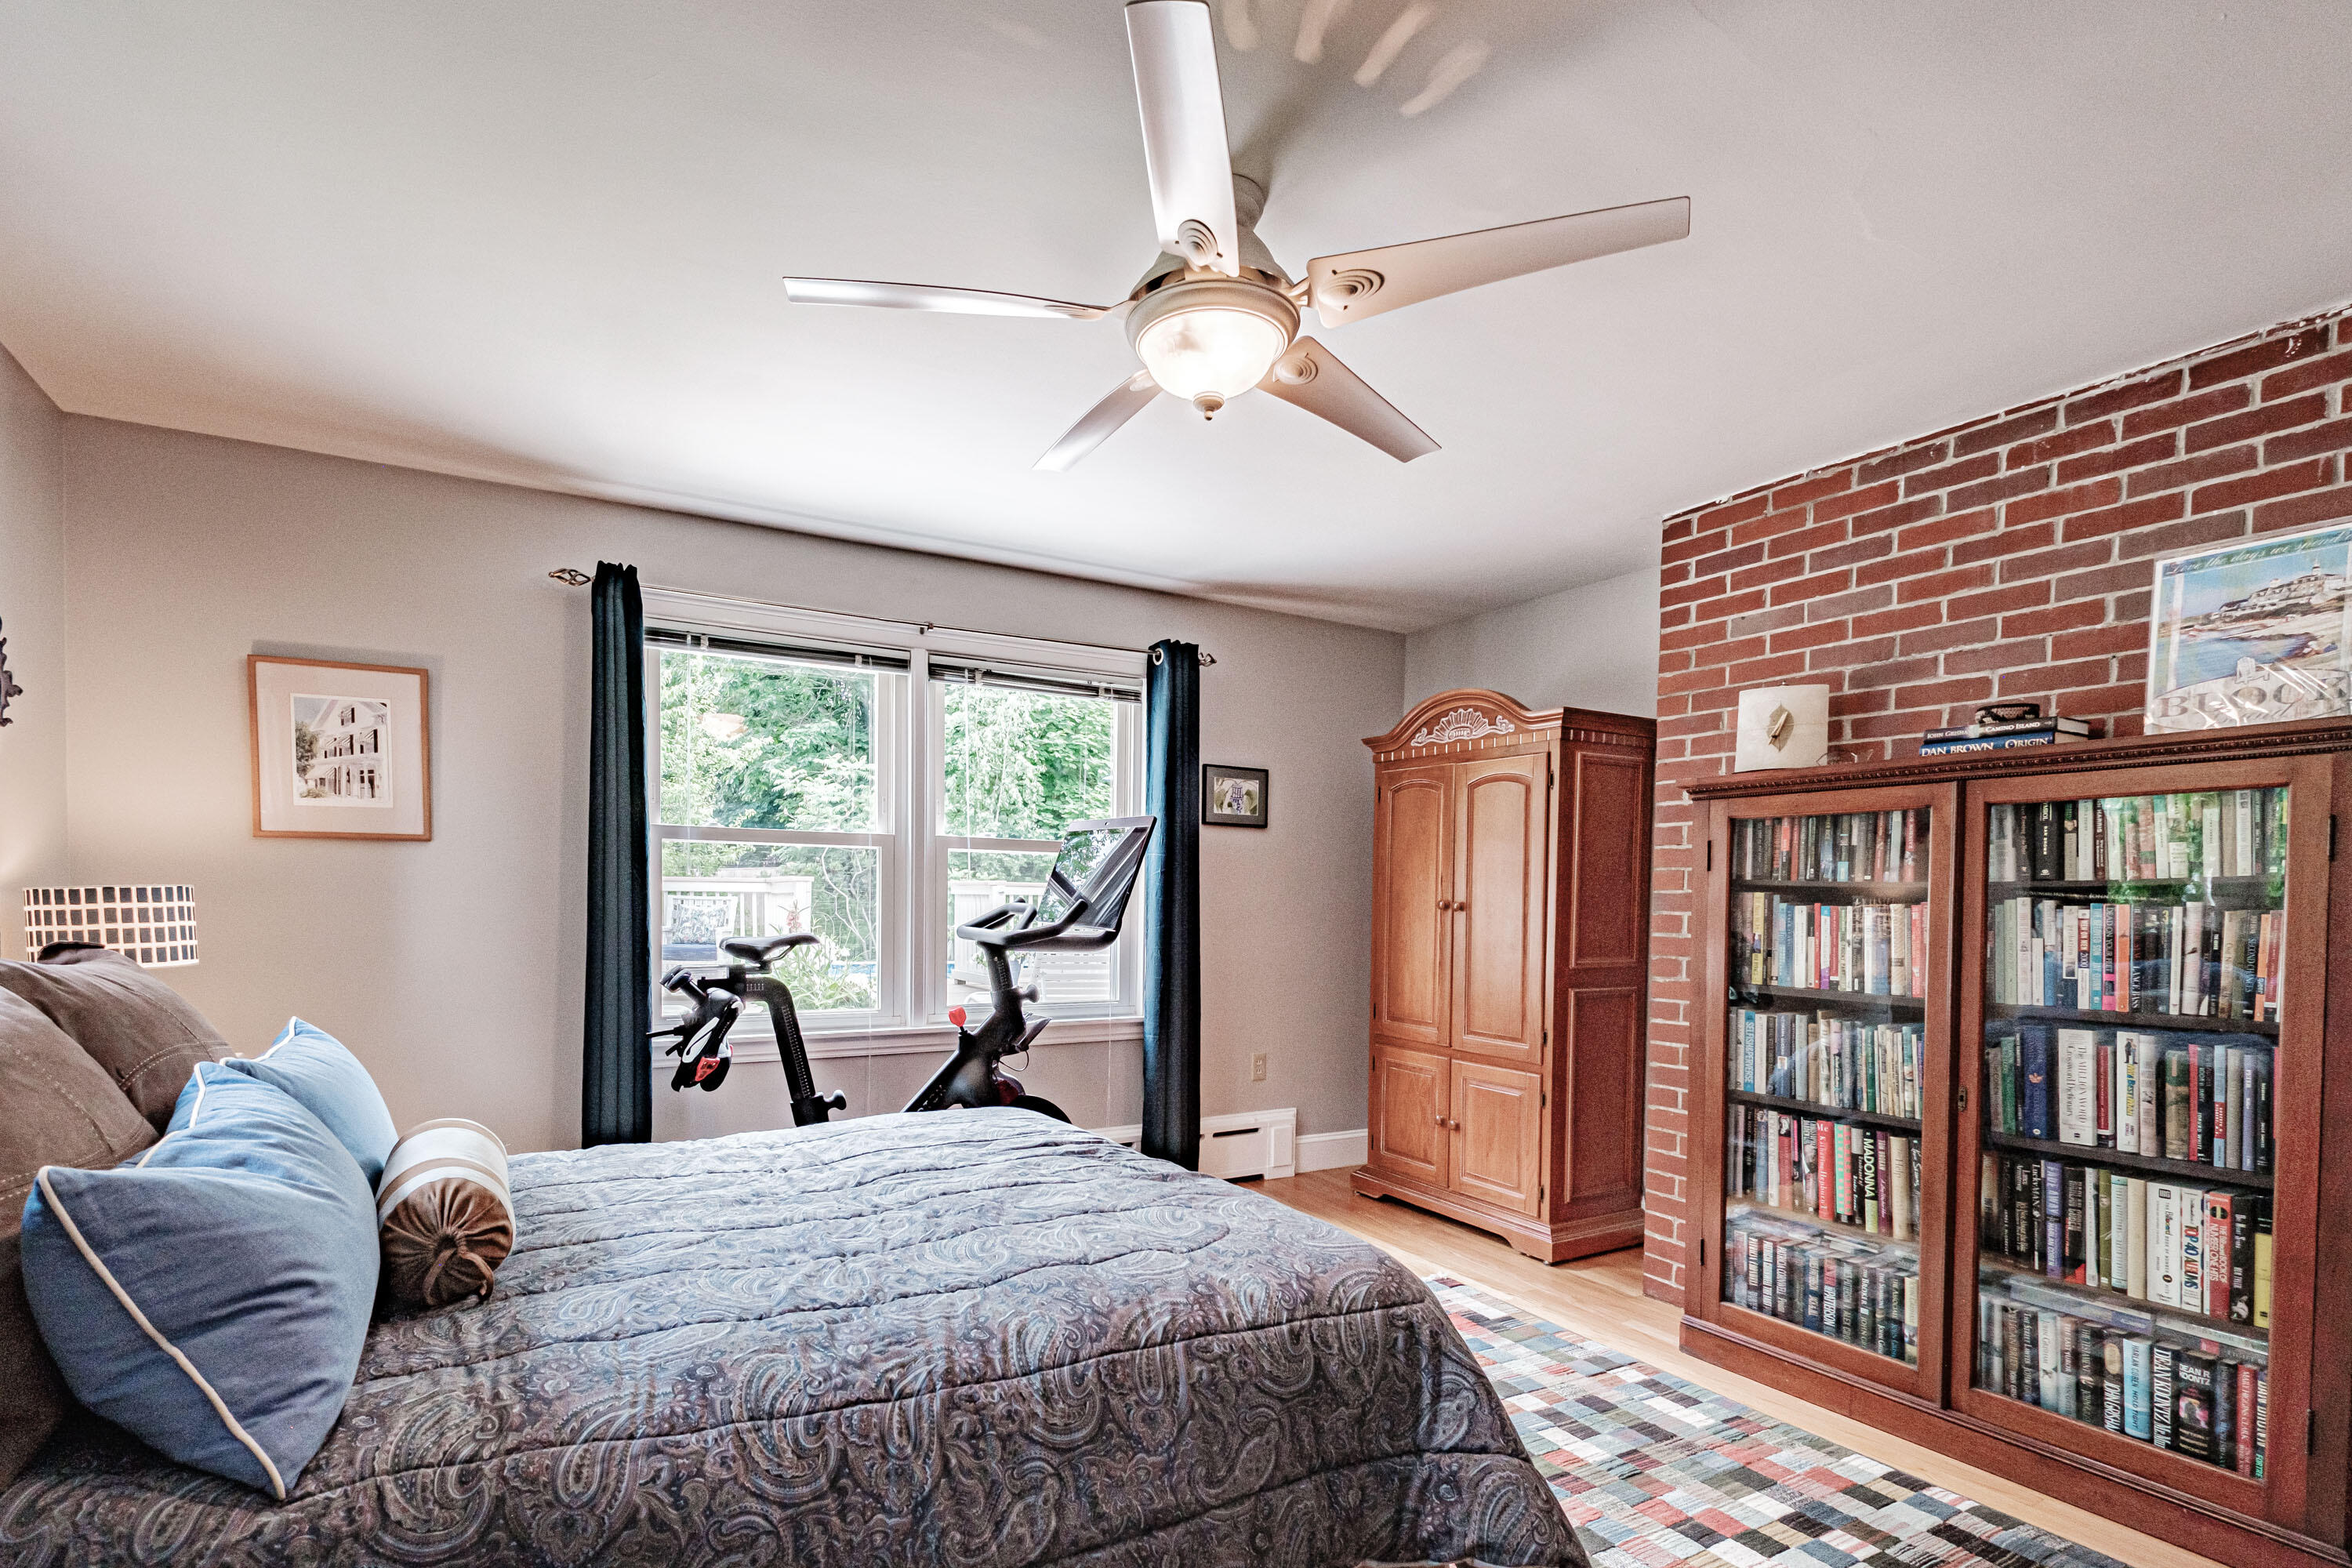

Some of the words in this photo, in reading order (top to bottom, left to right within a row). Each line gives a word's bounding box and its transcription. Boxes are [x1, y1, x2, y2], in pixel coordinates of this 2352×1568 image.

[1944, 728, 1970, 737] GRISHA
[1985, 724, 2015, 732] CAMINO
[2016, 721, 2041, 730] ISLAND
[1922, 746, 1947, 757] DAN
[1950, 742, 1994, 753] BROWN
[2005, 737, 2049, 749] ORIGIN
[2106, 907, 2114, 925] DEAD
[2081, 920, 2089, 931] MEN
[2106, 927, 2114, 937] ON
[2081, 940, 2089, 950] MEN
[2106, 938, 2114, 956] YOUR
[2247, 938, 2256, 964] SECOND
[2106, 958, 2114, 972] FEET
[2132, 966, 2140, 989] LANCE
[2245, 964, 2254, 993] CHANCES
[2132, 991, 2140, 1008] BASS
[2078, 1047, 2087, 1058] The
[2067, 1046, 2076, 1082] Crossword
[2078, 1061, 2087, 1095] MILLION
[2127, 1079, 2136, 1096] BEST
[2066, 1083, 2076, 1116] Dictionary
[2078, 1098, 2087, 1123] WORD
[1864, 1138, 1875, 1197] MADONNA
[2049, 1189, 2060, 1214] AWAY
[2164, 1211, 2174, 1236] Billboard
[2184, 1225, 2199, 1242] TOP
[1777, 1247, 1787, 1269] PATRICIA
[2184, 1243, 2199, 1256] 40
[1777, 1269, 1787, 1294] CORNWELL
[2184, 1257, 2199, 1289] ALBUMS
[2220, 1274, 2227, 1283] OF
[1824, 1290, 1835, 1327] PATTERSON
[2154, 1348, 2171, 1378] DEAN
[2179, 1363, 2201, 1375] DEAN
[2024, 1367, 2032, 1383] JOHN
[2179, 1371, 2210, 1385] KOONTZ
[2103, 1380, 2121, 1404] JOHN
[2154, 1378, 2171, 1425] KOONTZ
[2241, 1417, 2249, 1440] CLARK
